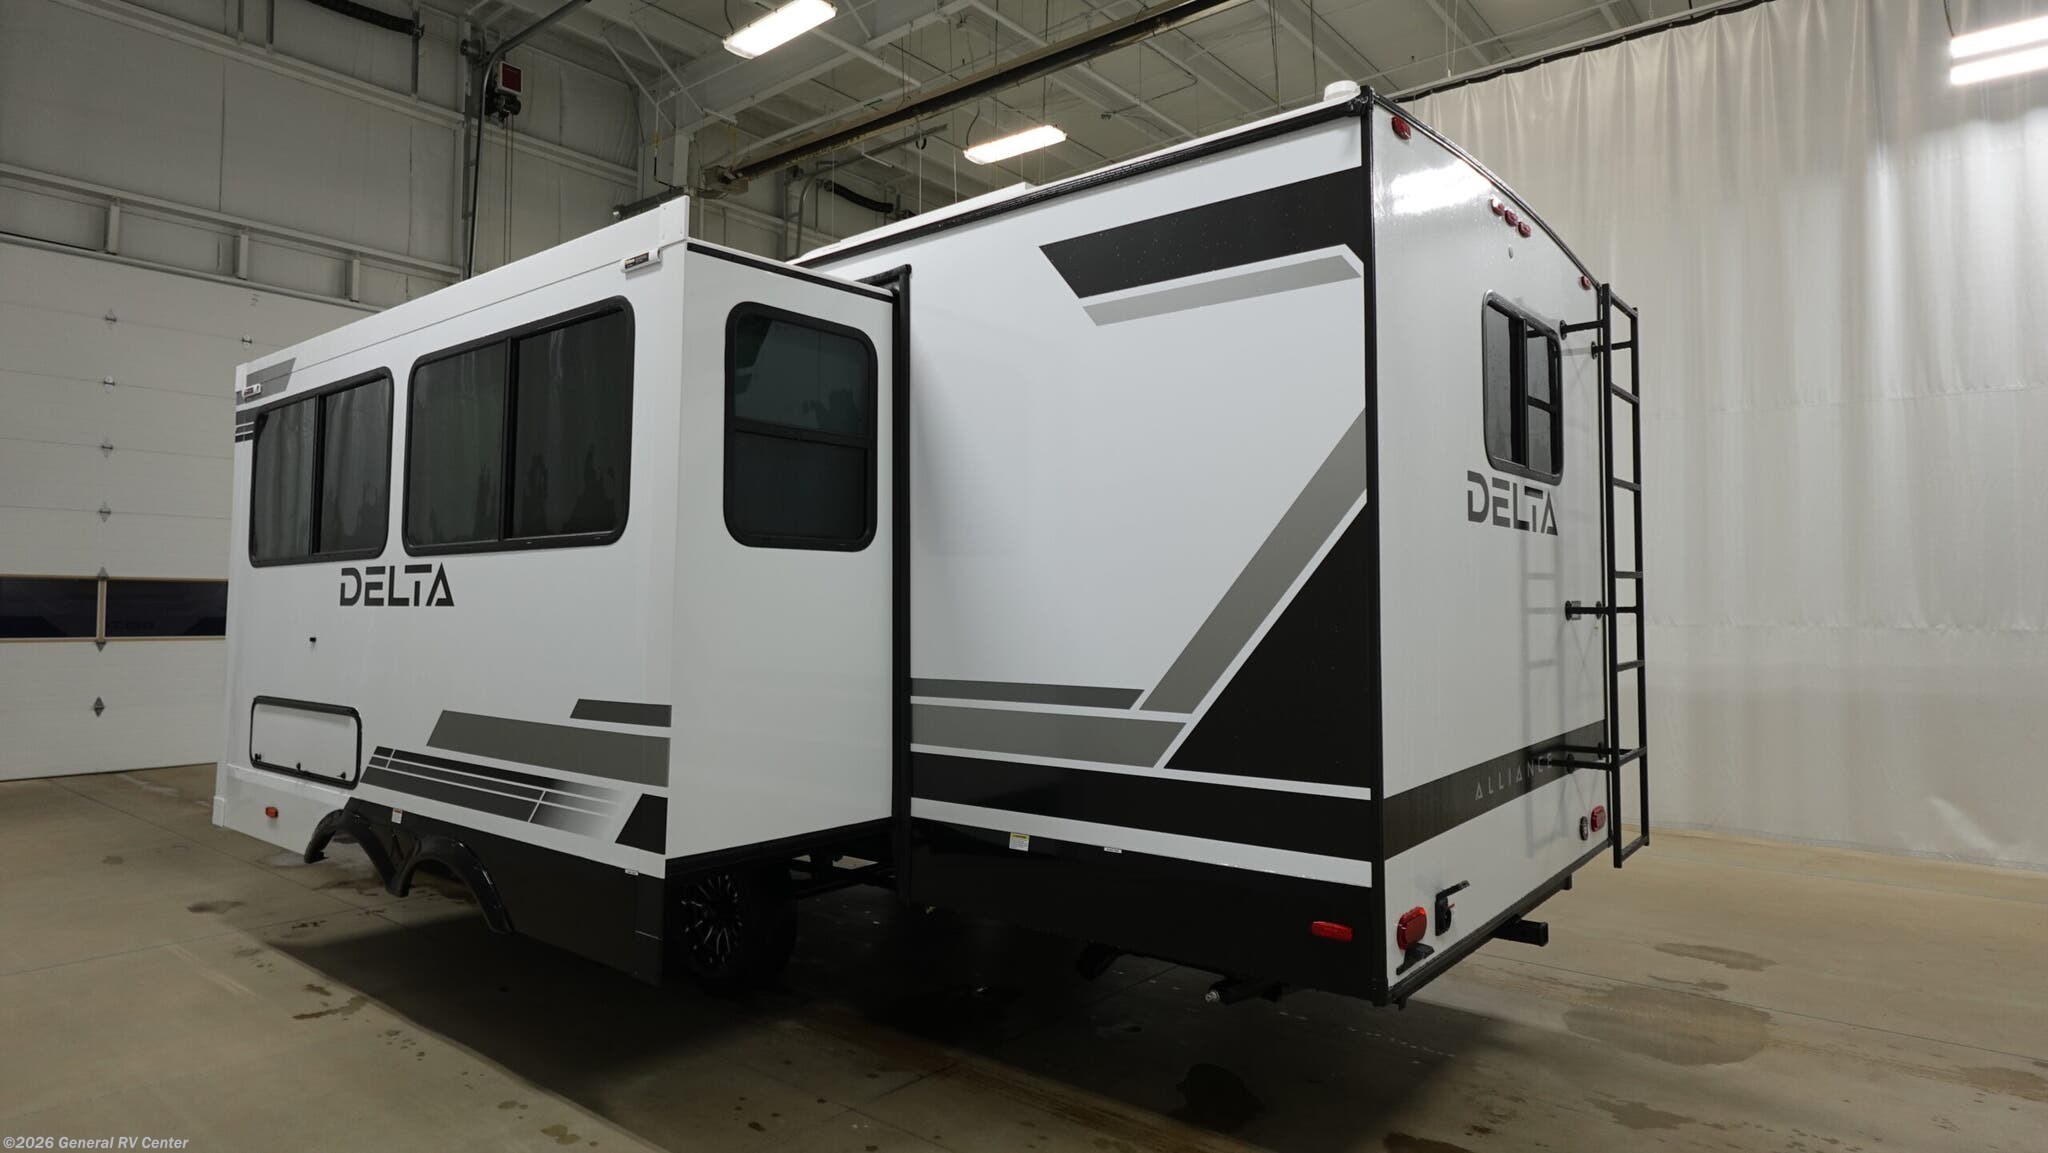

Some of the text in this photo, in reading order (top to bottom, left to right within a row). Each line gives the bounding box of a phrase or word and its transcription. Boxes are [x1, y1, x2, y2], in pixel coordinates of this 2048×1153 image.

[1467, 470, 1558, 536] DELTA
[340, 562, 455, 607] DELTA
[1475, 752, 1553, 801] ALLIANCE
